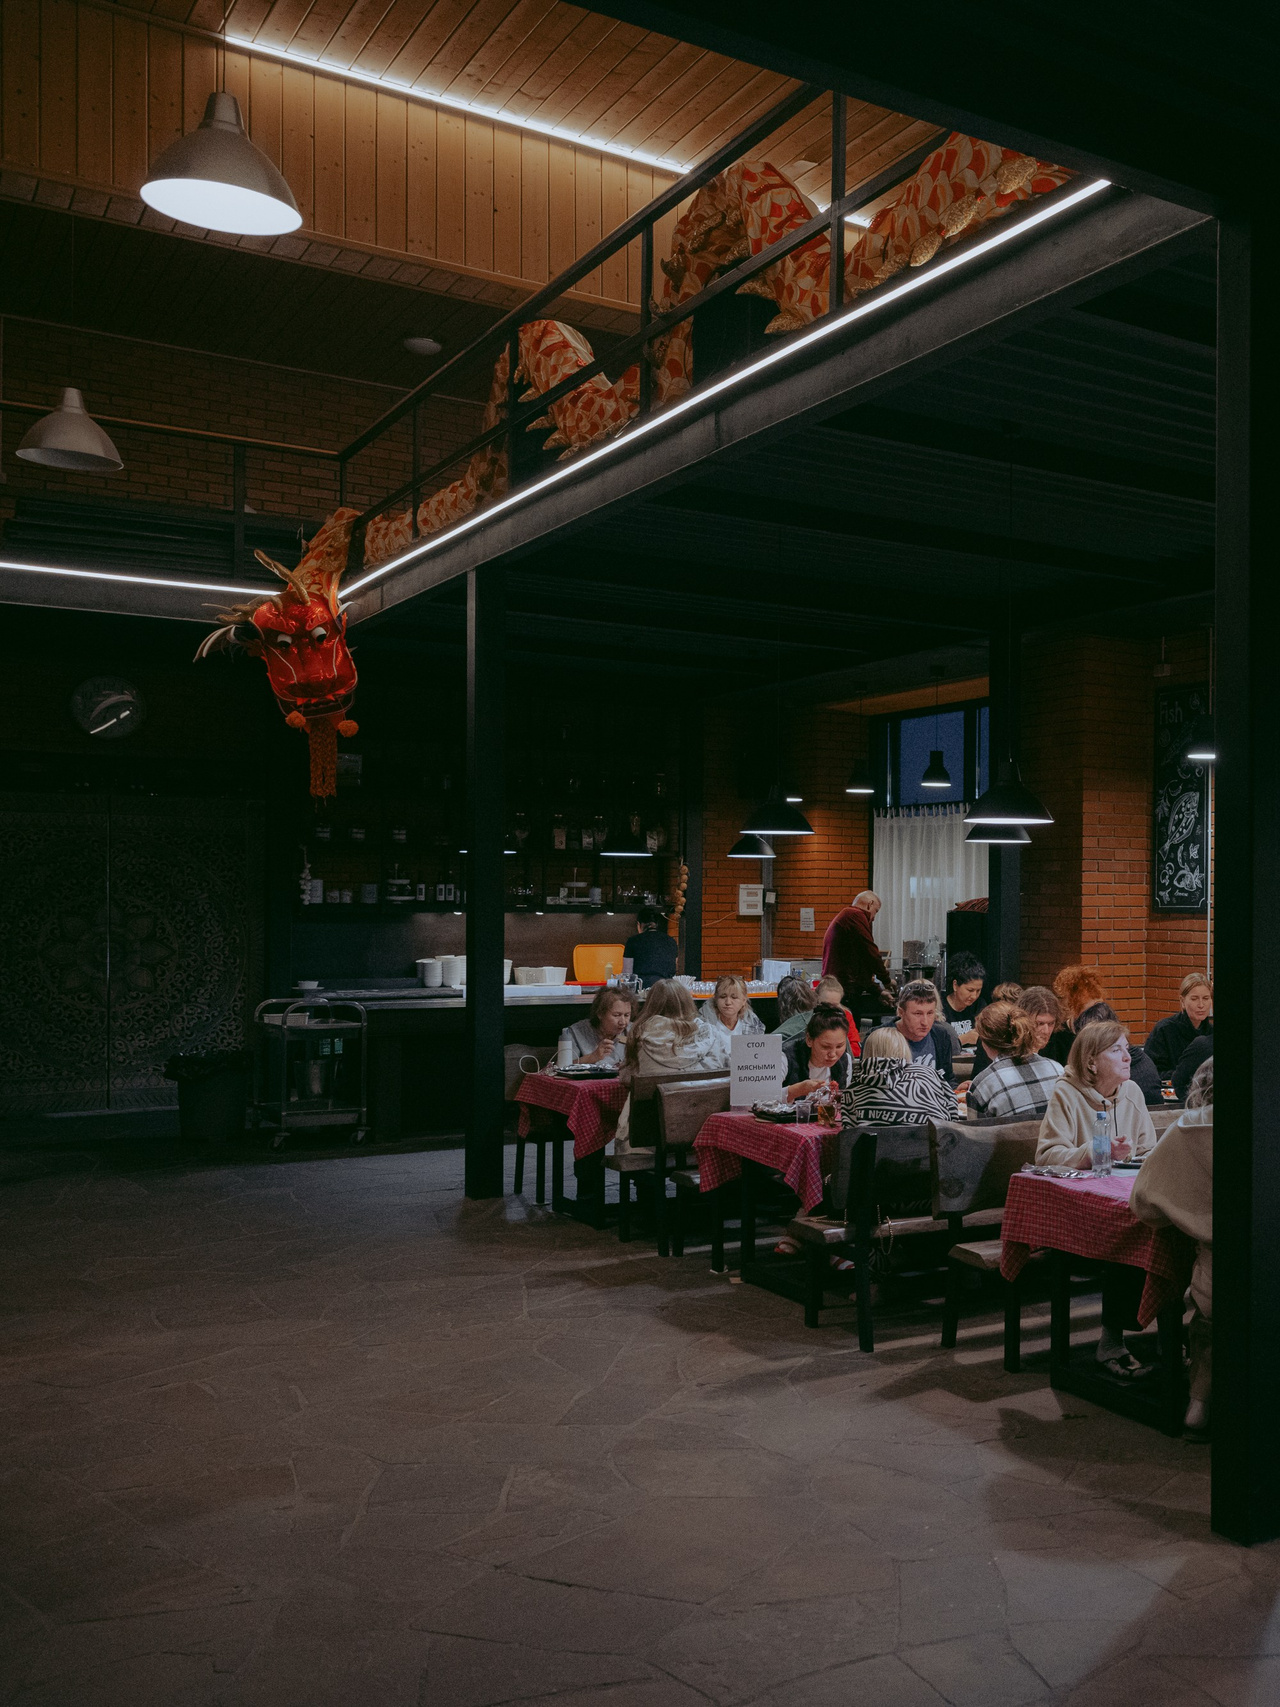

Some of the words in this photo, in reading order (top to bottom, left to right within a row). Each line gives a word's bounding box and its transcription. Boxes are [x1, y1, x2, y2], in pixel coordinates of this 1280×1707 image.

[1160, 700, 1183, 725] Fish
[738, 1075, 777, 1083] БЛЮДАМИ
[868, 1110, 897, 1122] ERAN
